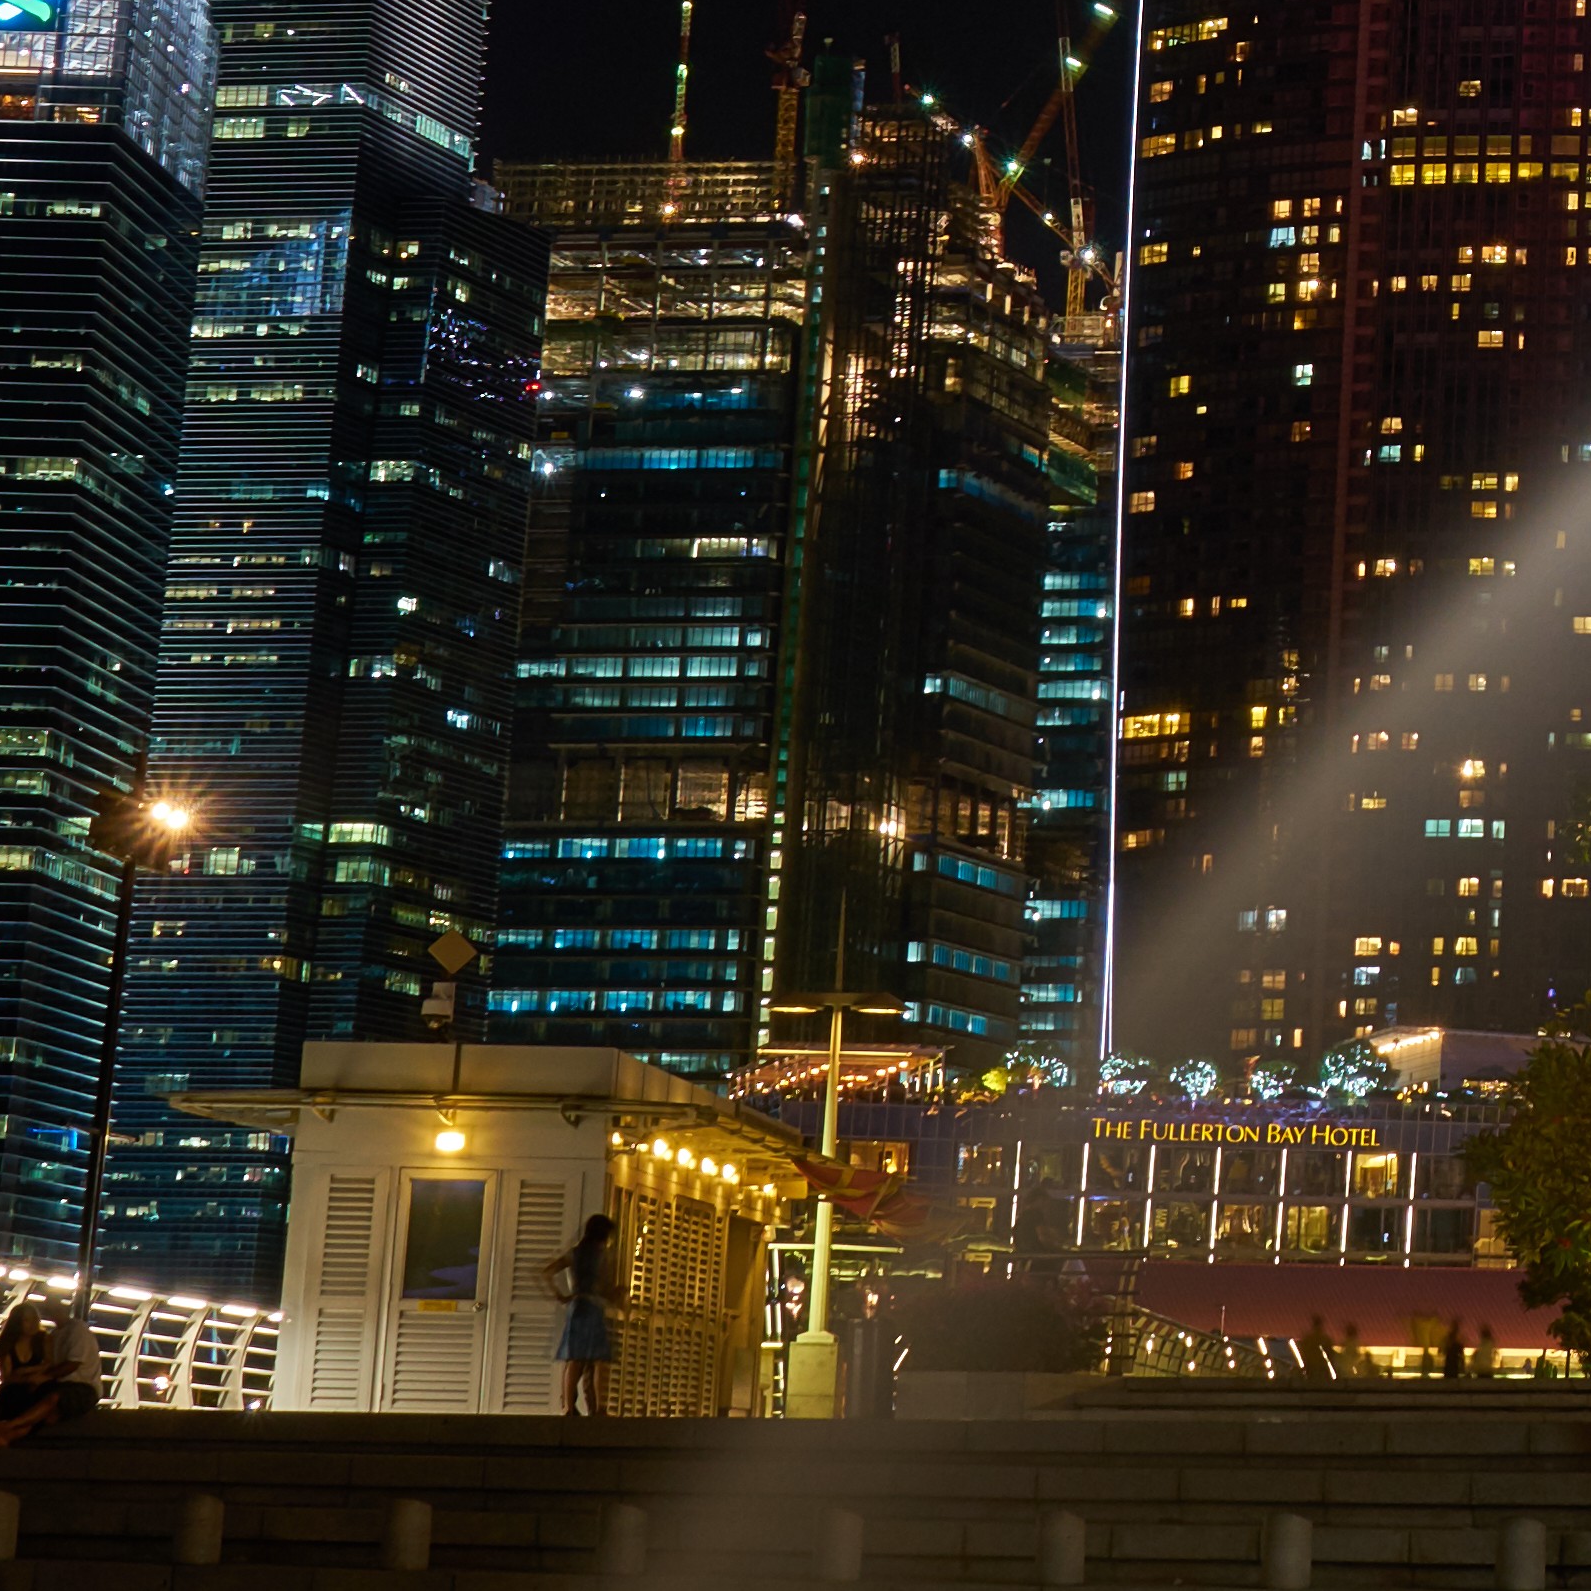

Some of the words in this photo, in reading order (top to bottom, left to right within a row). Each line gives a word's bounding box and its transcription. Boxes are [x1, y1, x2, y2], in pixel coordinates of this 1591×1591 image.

[1092, 1117, 1133, 1140] THE
[1139, 1119, 1260, 1143] FULLERTON
[1311, 1124, 1380, 1147] HOTEL
